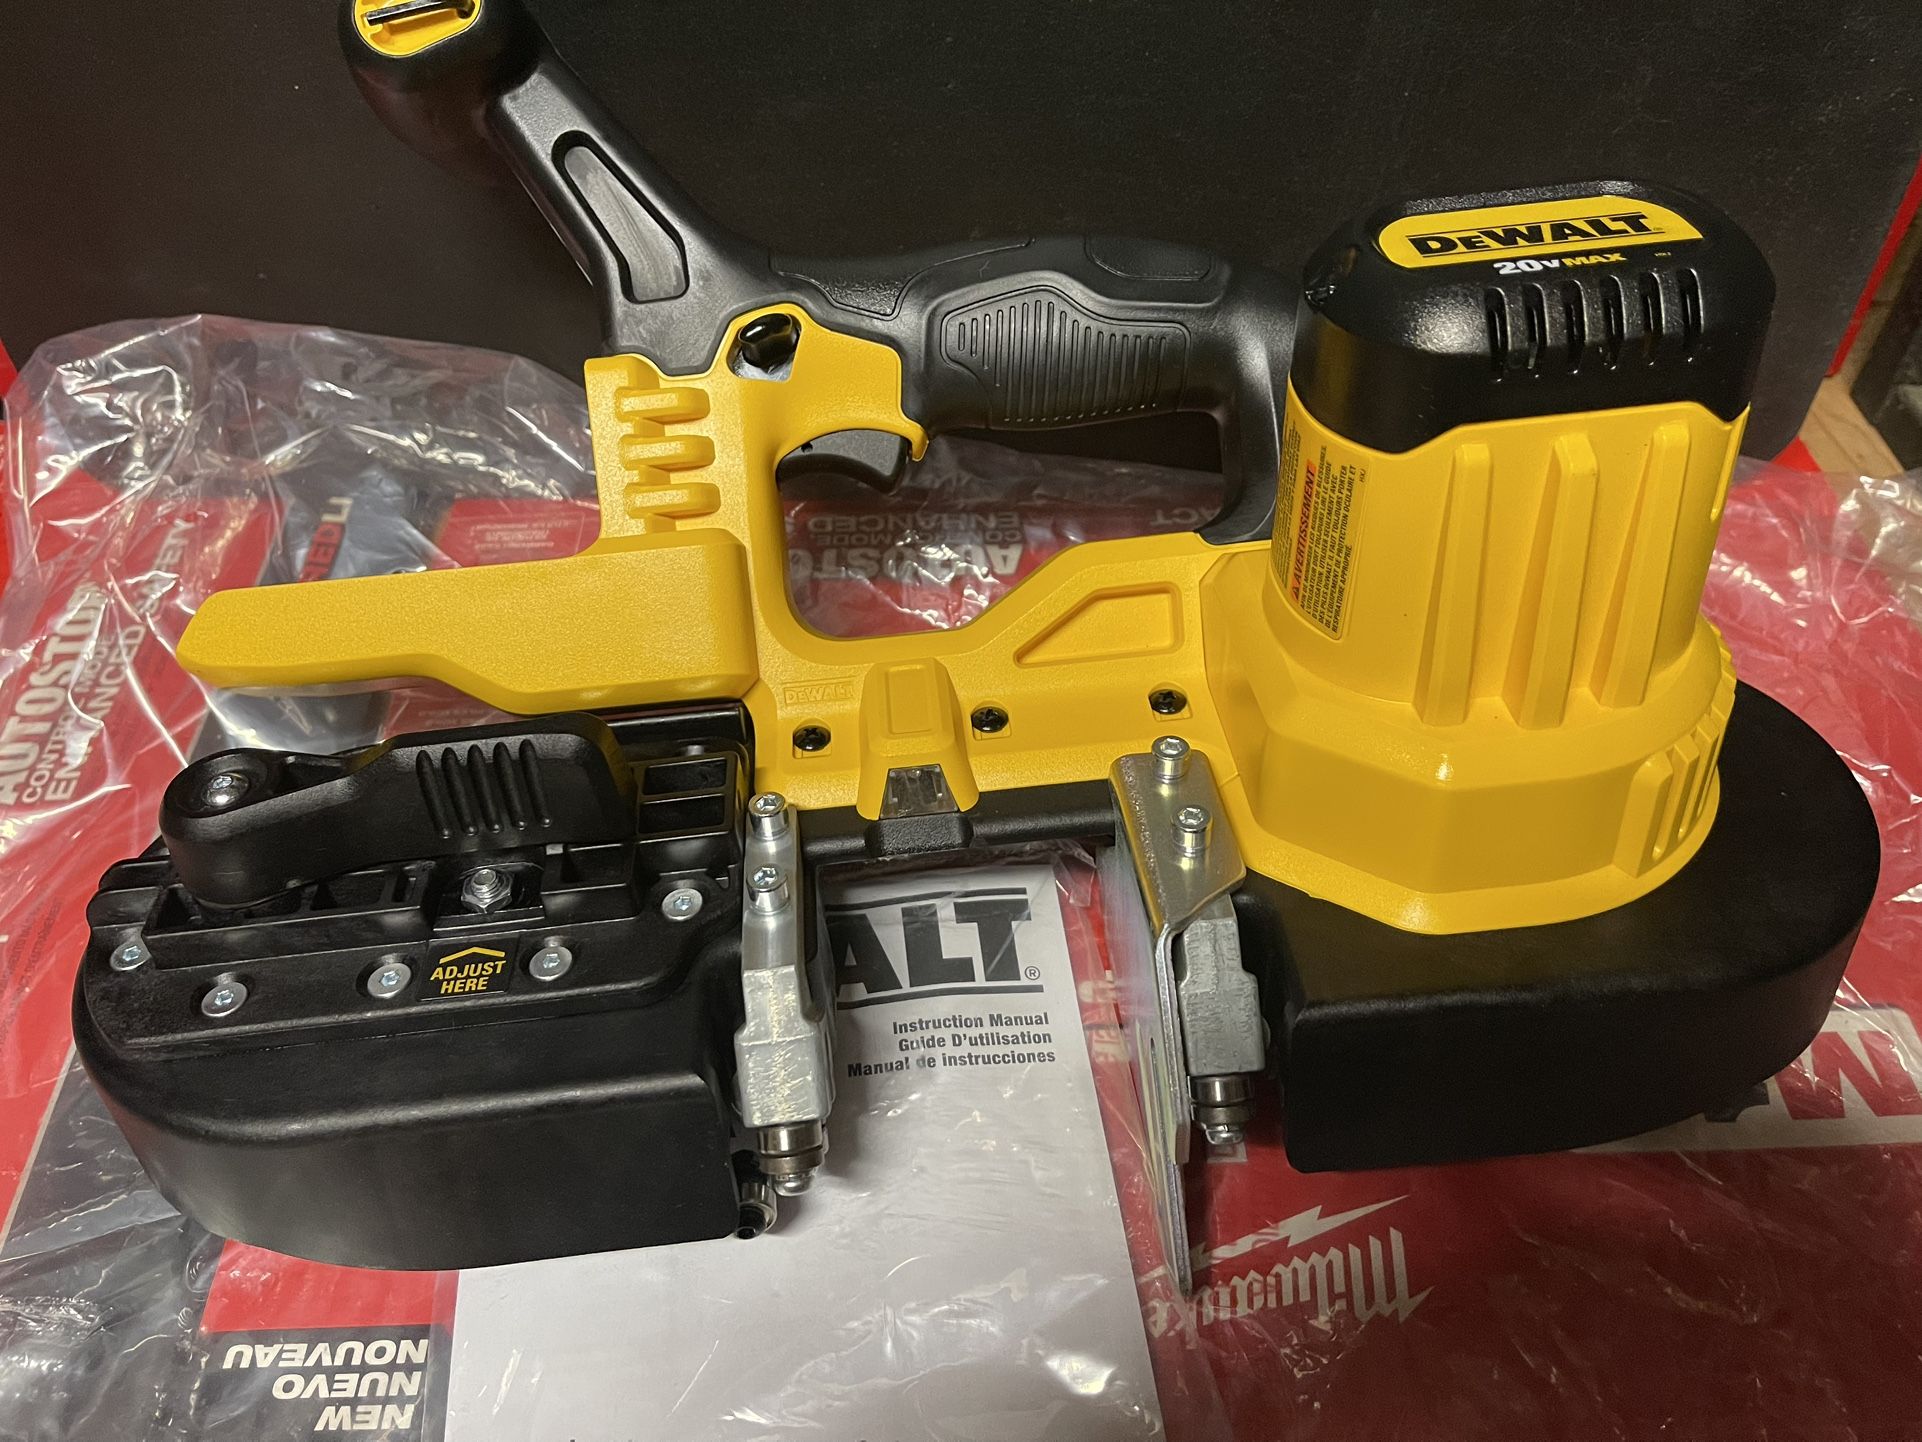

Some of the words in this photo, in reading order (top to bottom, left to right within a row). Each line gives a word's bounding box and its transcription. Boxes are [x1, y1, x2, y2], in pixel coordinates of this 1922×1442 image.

[1561, 252, 1627, 267] MAX
[429, 960, 507, 981] ADJUST
[440, 976, 489, 994] HERE
[893, 1015, 984, 1035] Instruction
[989, 1012, 1050, 1028] Manual
[898, 1035, 946, 1052] Guide
[952, 1031, 1052, 1048] D'utilisation
[847, 1057, 910, 1078] Manual
[942, 1050, 1056, 1067] instrucciones
[222, 1339, 429, 1369] NOUVEAU
[272, 1371, 422, 1399] NUEVO
[314, 1403, 415, 1431] NEW
